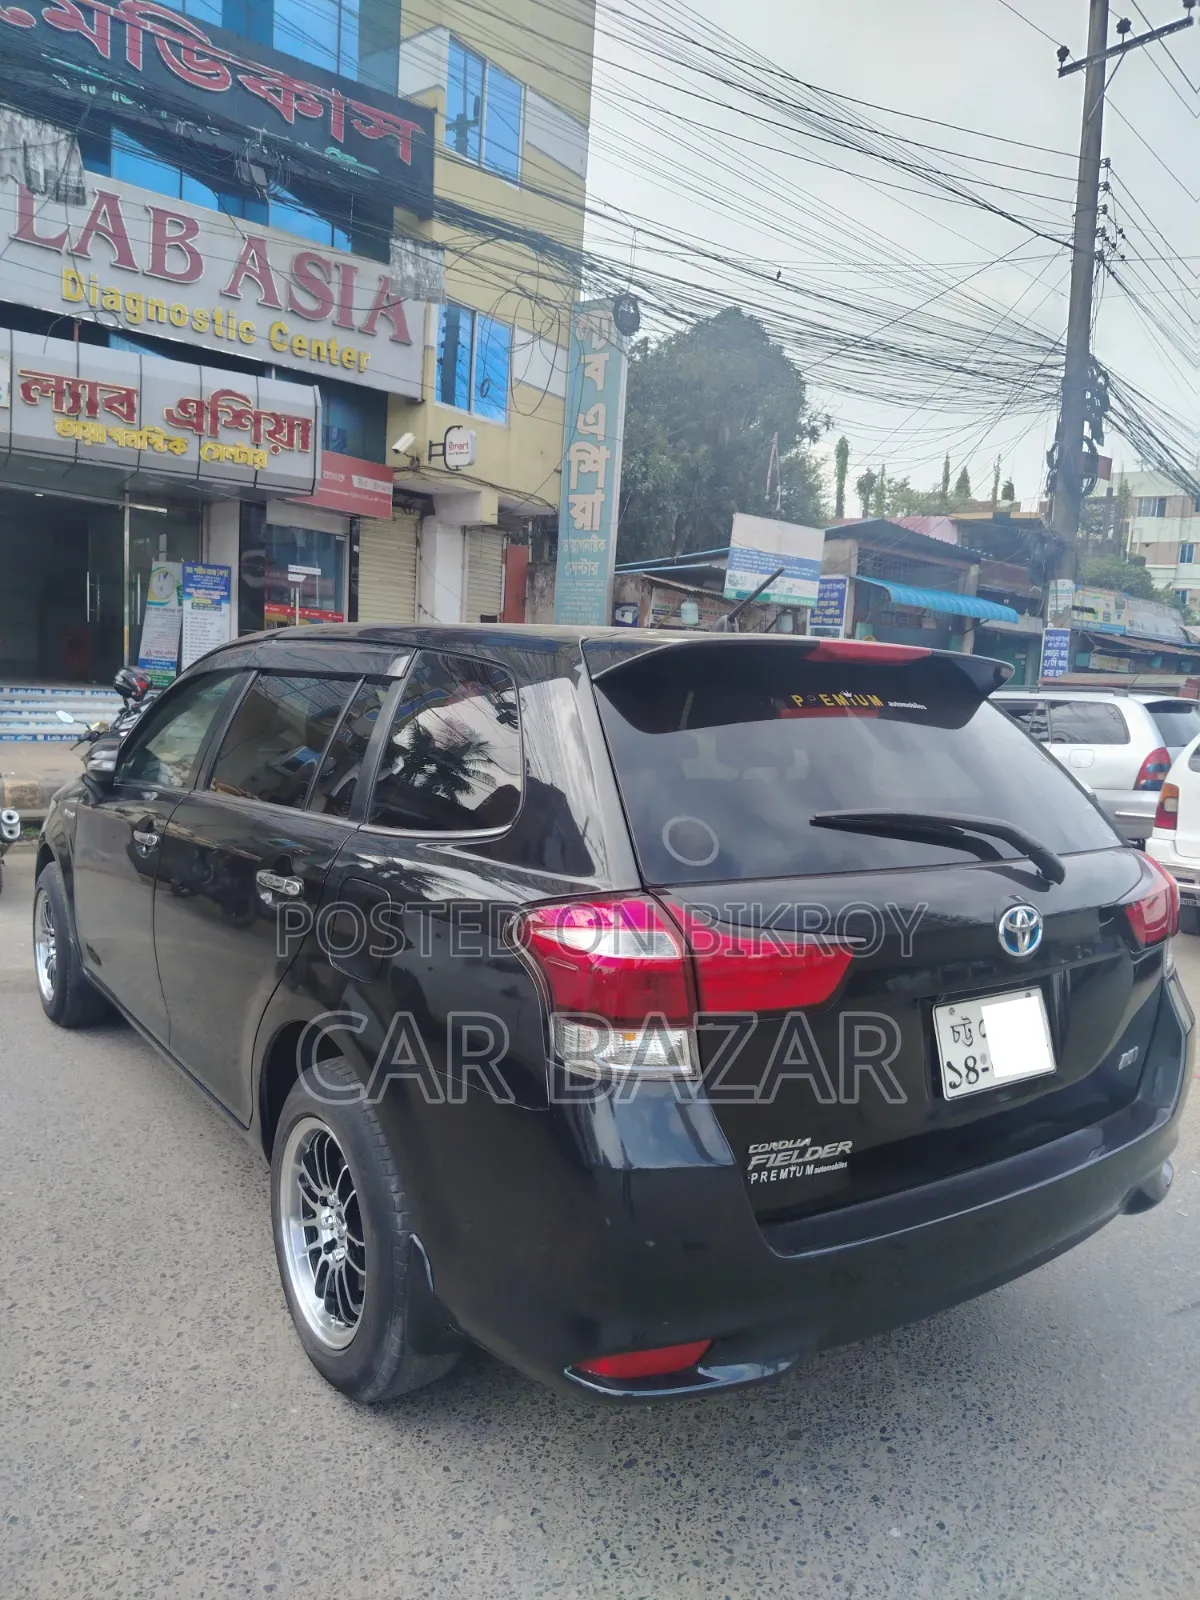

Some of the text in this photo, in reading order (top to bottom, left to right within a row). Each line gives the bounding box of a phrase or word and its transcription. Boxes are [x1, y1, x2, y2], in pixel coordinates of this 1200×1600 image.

[9, 183, 414, 346] LAB ASIA
[61, 266, 372, 374] Diagnostic Center
[18, 368, 313, 456] ল্যাব এশিয়া
[199, 441, 269, 471] সেন্টার
[791, 693, 884, 708] PEMIUM
[747, 1140, 853, 1171] FIELDER
[748, 1137, 812, 1154] COROLLA
